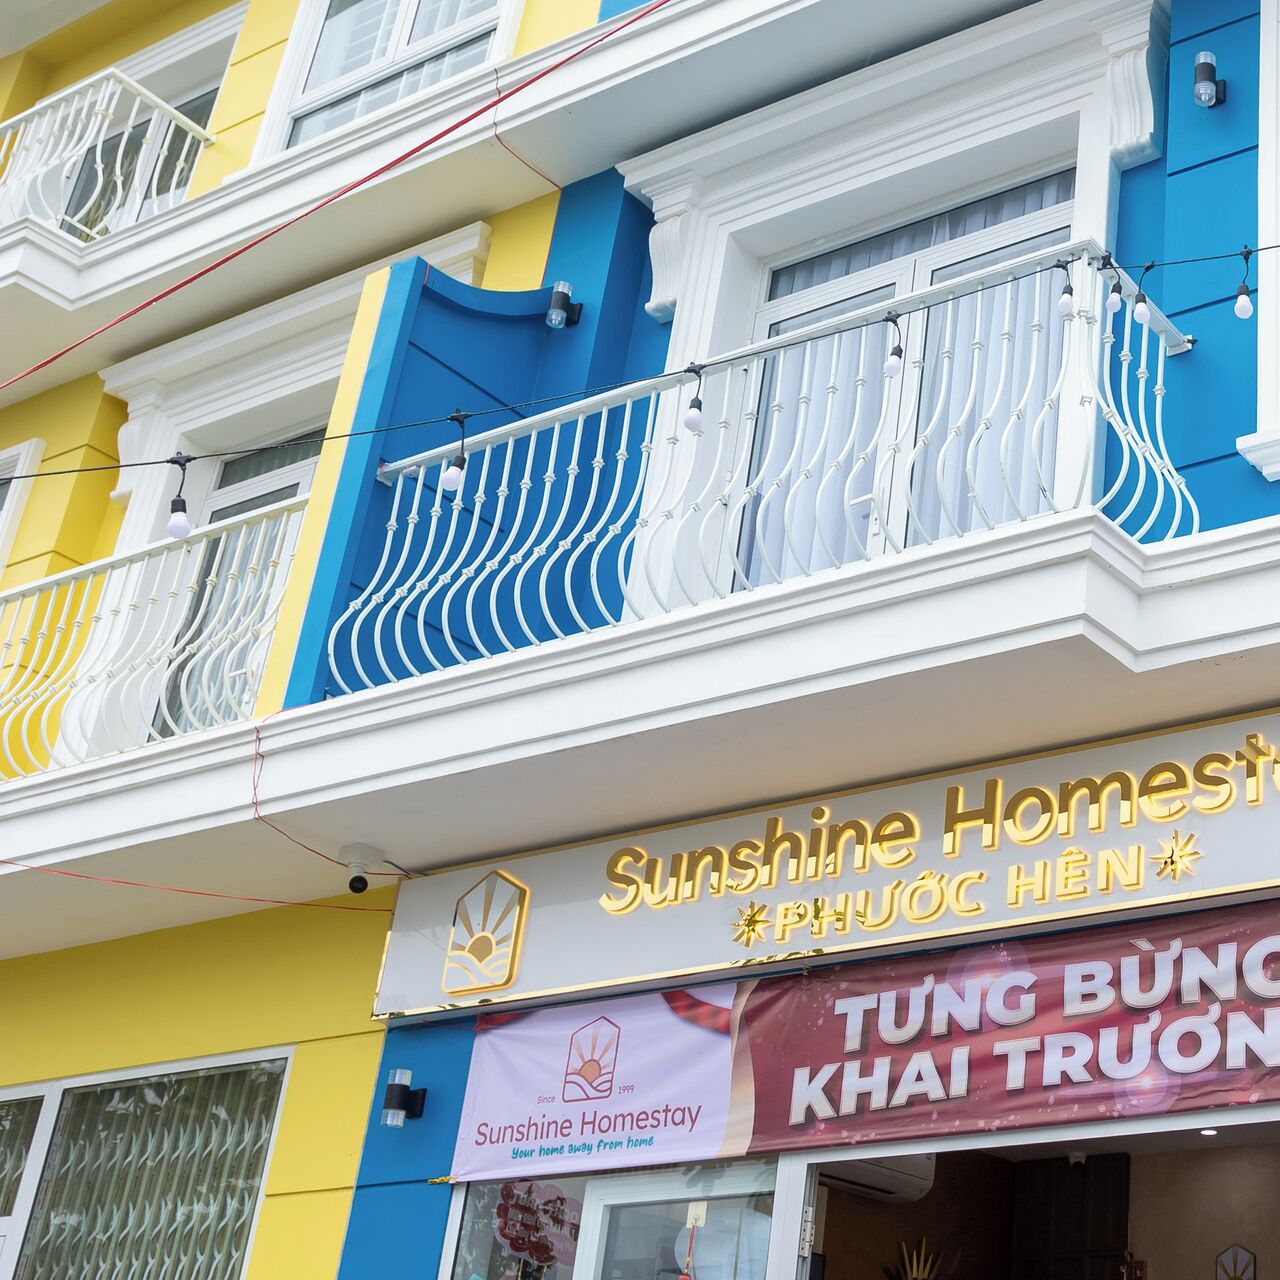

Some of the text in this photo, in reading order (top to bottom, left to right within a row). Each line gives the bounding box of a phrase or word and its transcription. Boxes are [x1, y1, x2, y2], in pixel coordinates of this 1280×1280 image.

[599, 806, 919, 915] Sunshine
[773, 845, 1146, 945] PHƯỚC HÊN
[833, 972, 1038, 1054] TƯNG
[474, 1103, 703, 1147] Sunshine Homestay
[537, 1084, 635, 1105] Since 1999
[788, 1045, 971, 1128] KHAI
[511, 1135, 654, 1160] Your home away from home
